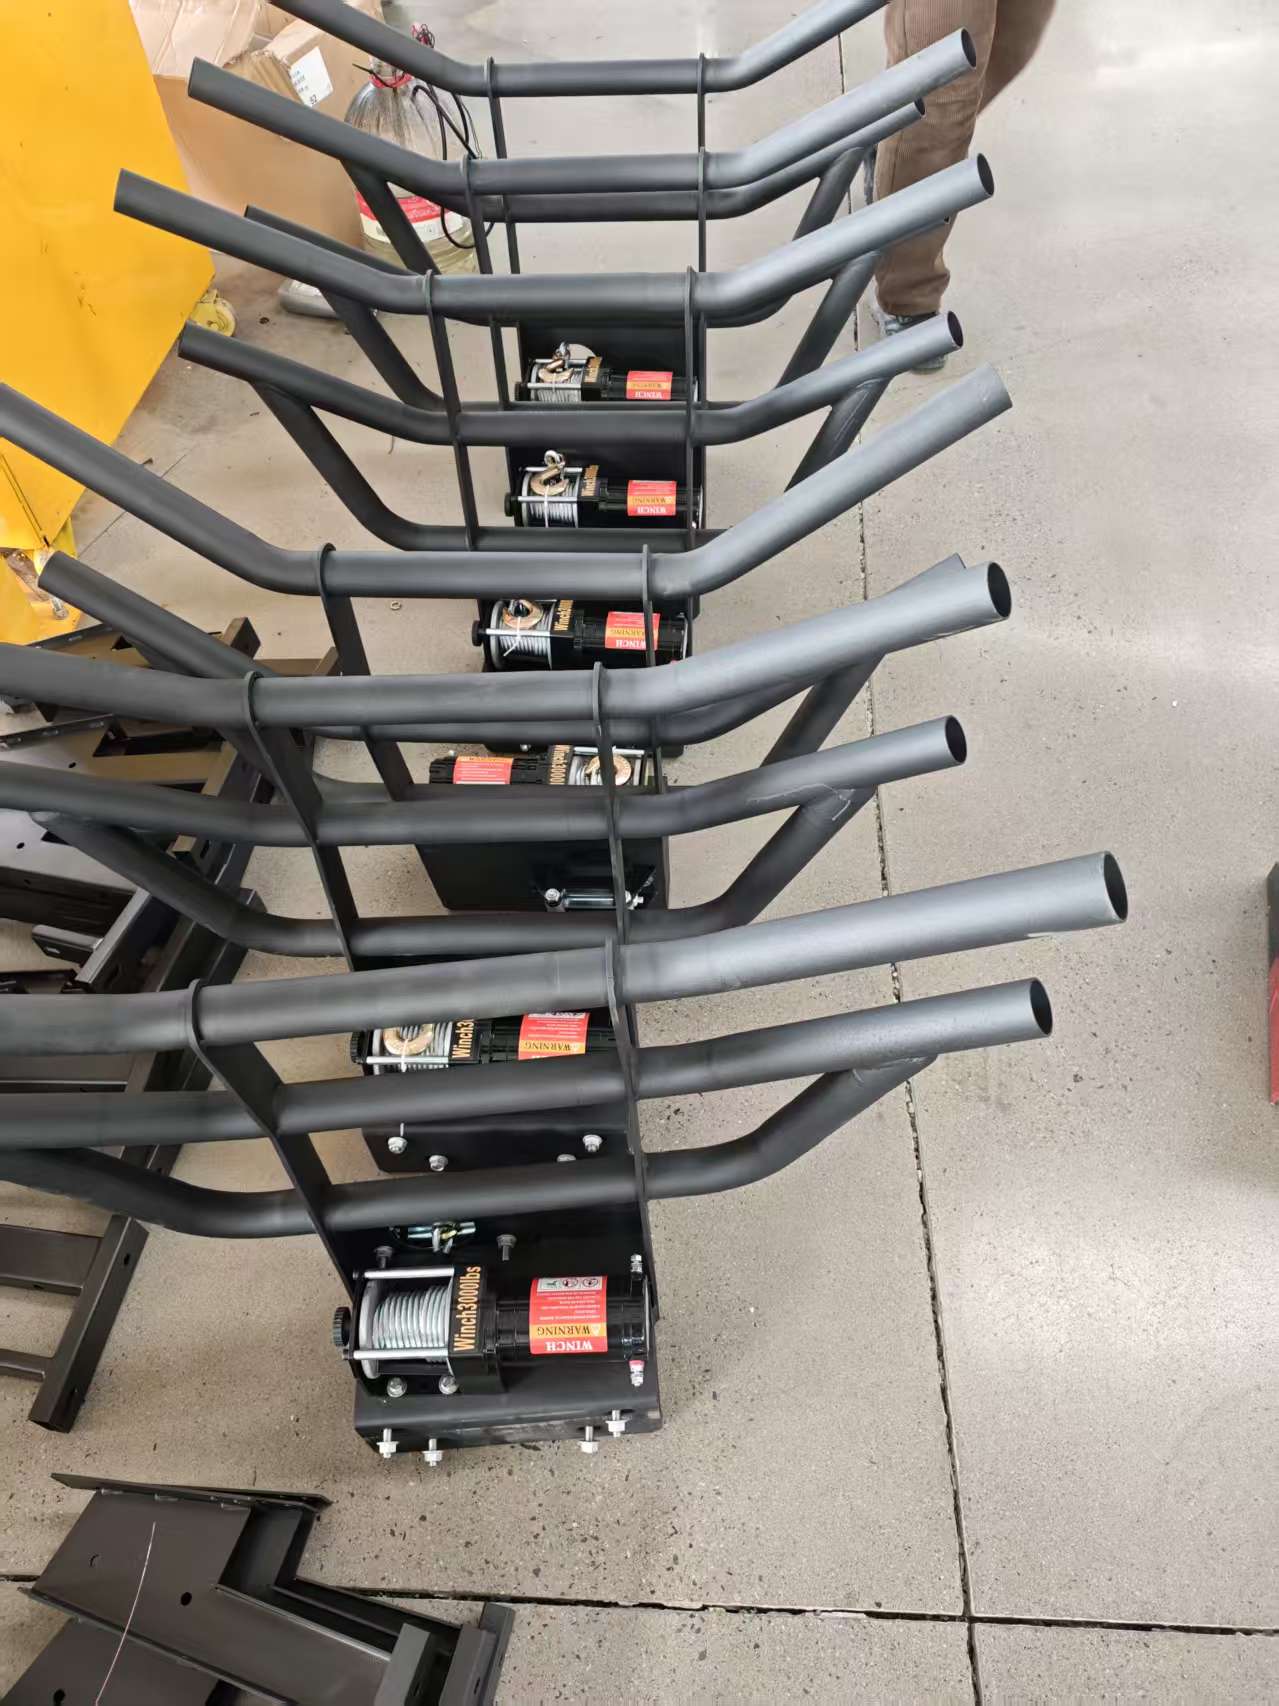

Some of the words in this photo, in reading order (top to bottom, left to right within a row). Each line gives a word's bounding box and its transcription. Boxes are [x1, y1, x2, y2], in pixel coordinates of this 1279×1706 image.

[525, 1042, 571, 1051] WARNING
[453, 1266, 482, 1352] Winch3000lbs
[537, 1324, 591, 1336] WARNING
[544, 1340, 593, 1351] WINCH
